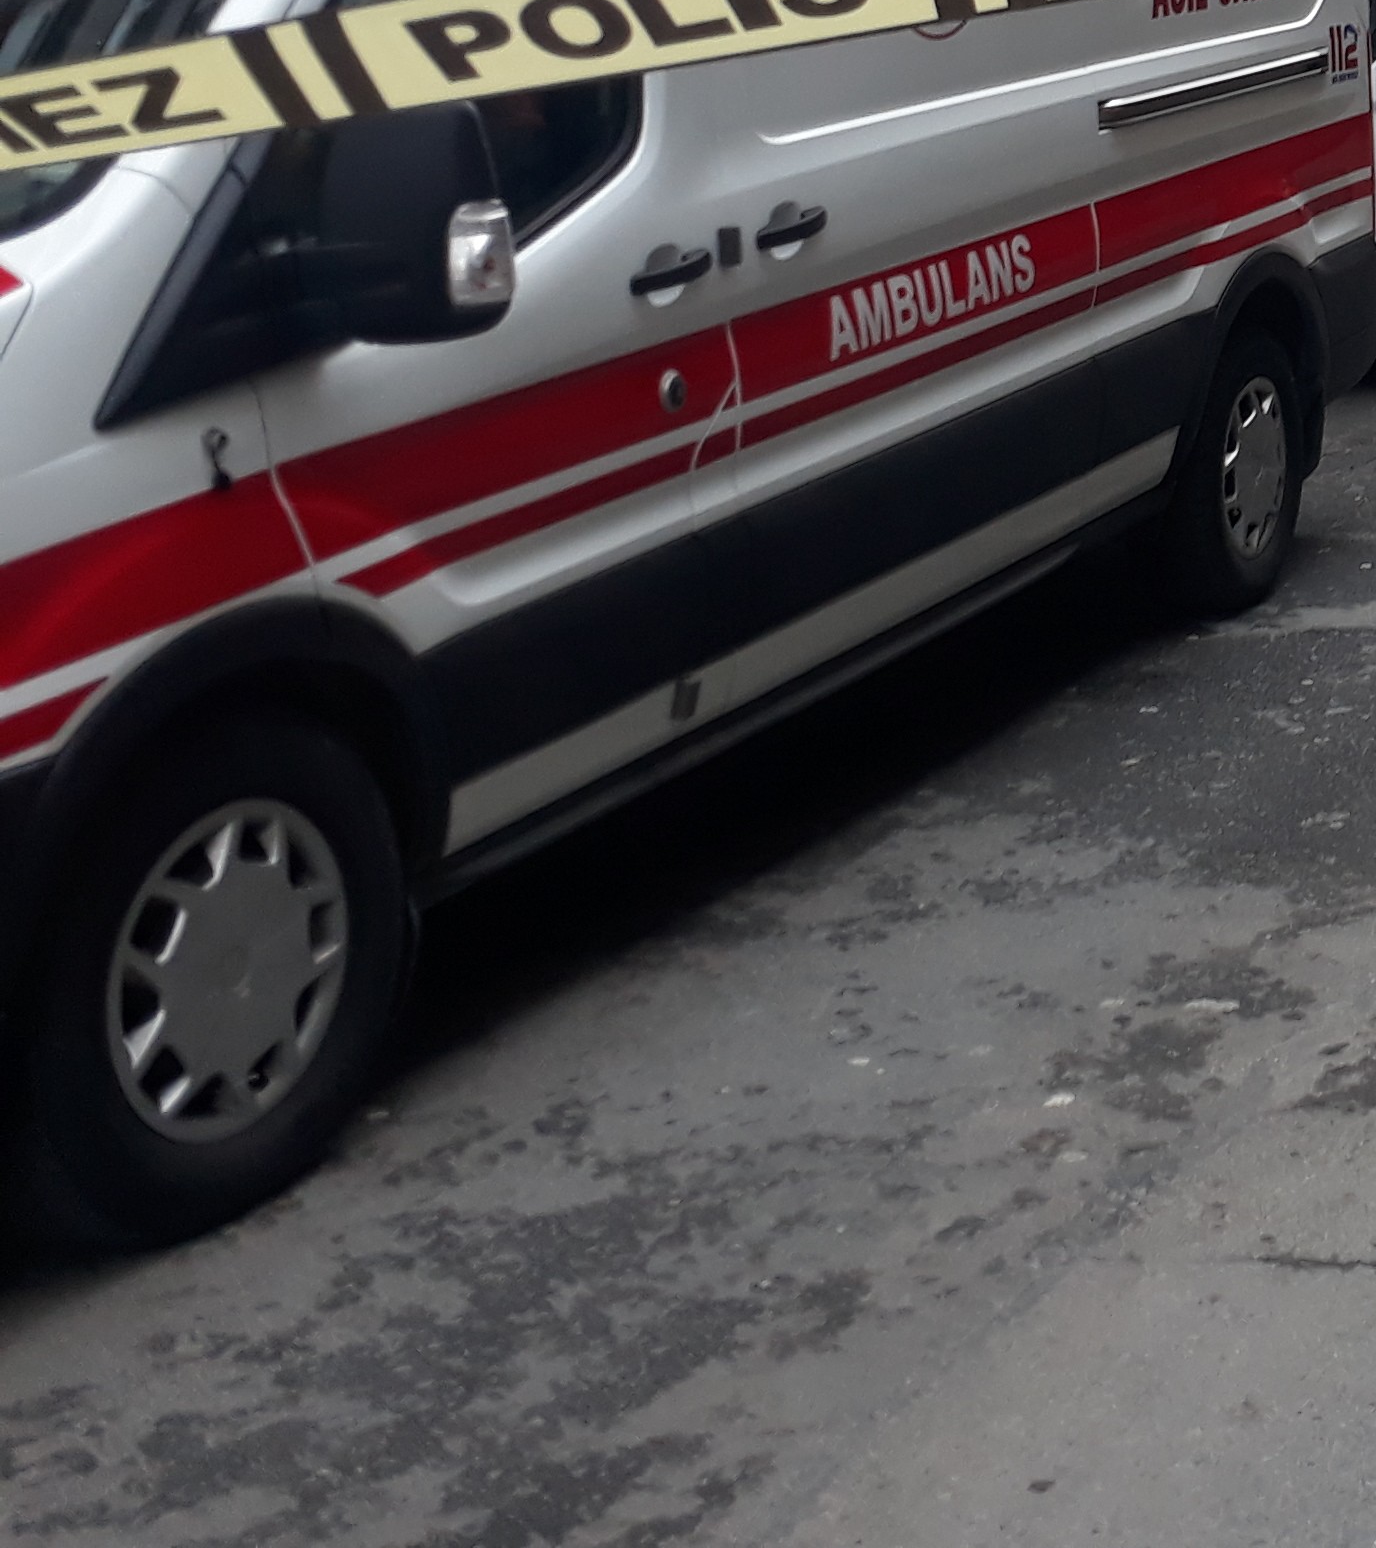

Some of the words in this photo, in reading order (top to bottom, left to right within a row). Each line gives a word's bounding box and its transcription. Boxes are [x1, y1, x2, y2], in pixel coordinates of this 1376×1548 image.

[1329, 24, 1359, 72] 112
[0, 66, 223, 155] EZ
[829, 233, 1036, 361] AMBULANS
